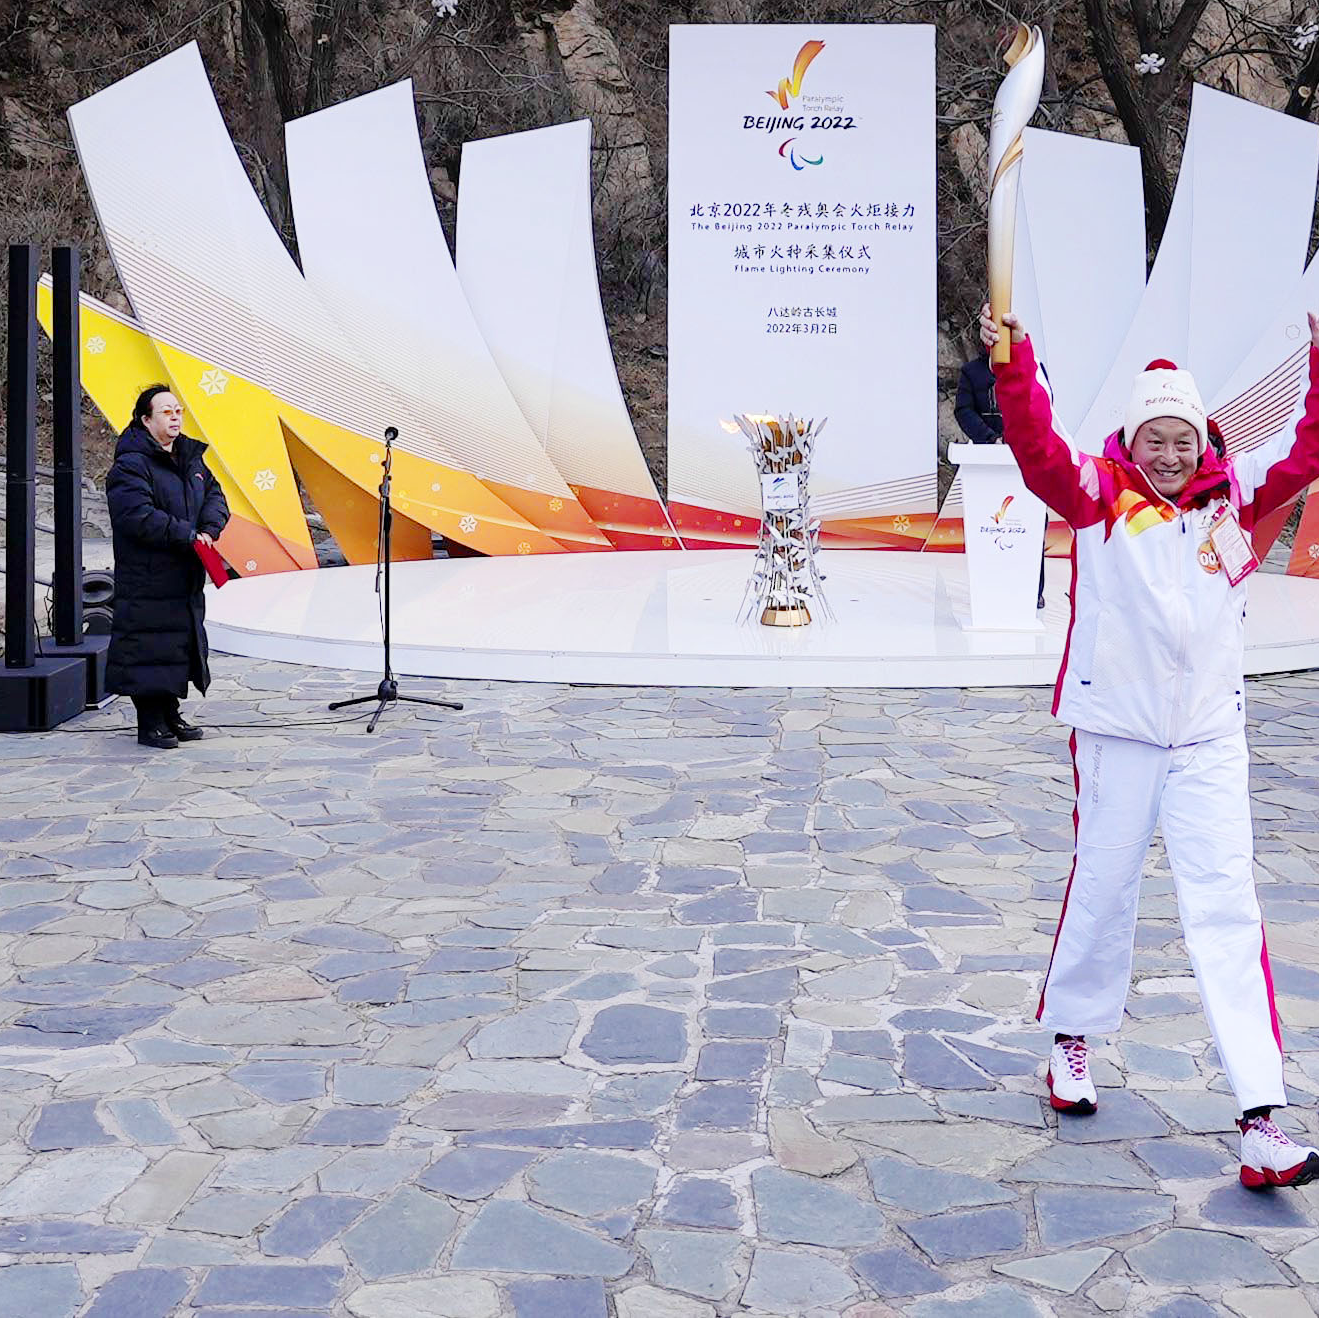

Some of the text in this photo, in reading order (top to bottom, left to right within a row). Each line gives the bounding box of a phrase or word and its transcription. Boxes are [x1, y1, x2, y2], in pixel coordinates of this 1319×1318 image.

[802, 95, 844, 104] Paralympic
[803, 104, 844, 113] Torch Relay
[743, 115, 858, 134] BEIJING 2022
[689, 201, 915, 218] 北京2022年冬残奥会火炬接力
[691, 222, 914, 233] The Beijing 2022 Paralympic Torch Relay
[733, 243, 872, 260] 城市火种采集仪式
[734, 264, 870, 275] Flame Lighting Ceremony
[767, 306, 838, 318] 八达岭古长城
[766, 323, 838, 335] 2022年3月2日
[1199, 552, 1217, 566] 00
